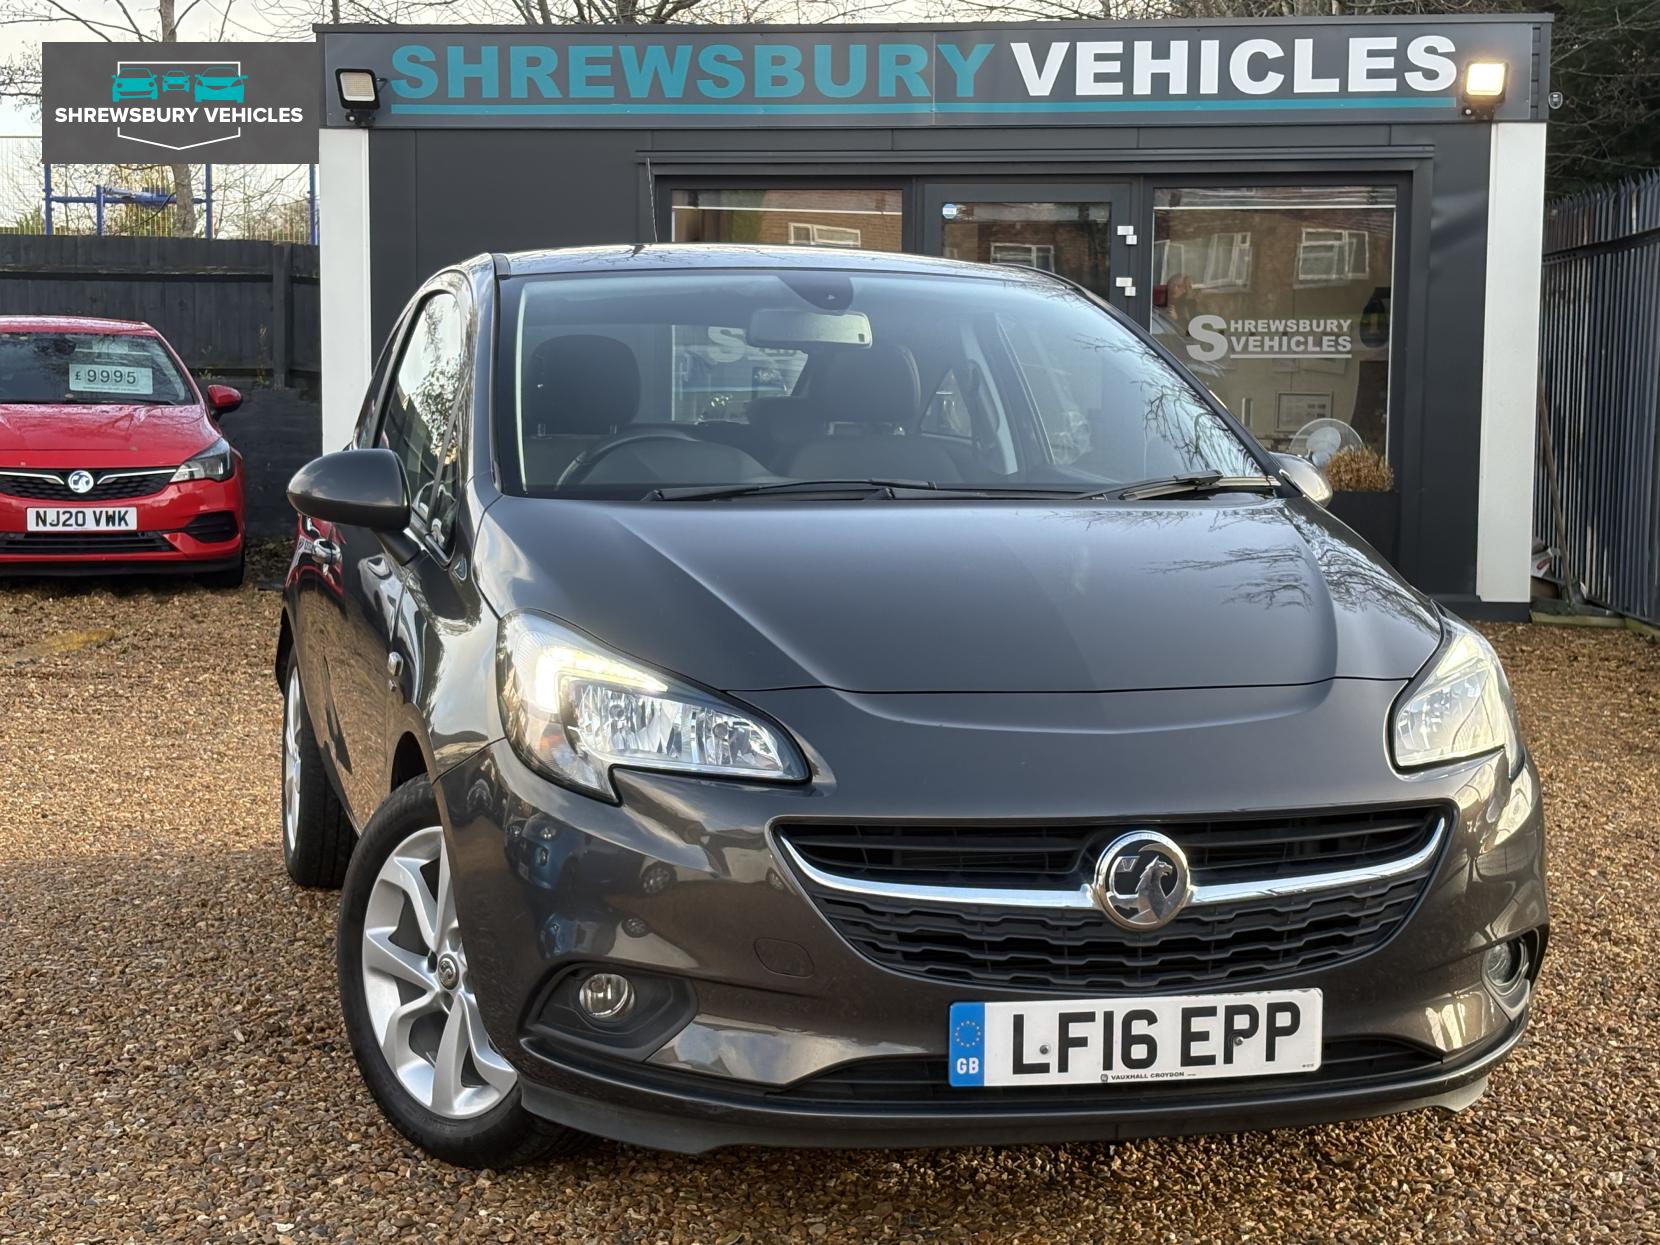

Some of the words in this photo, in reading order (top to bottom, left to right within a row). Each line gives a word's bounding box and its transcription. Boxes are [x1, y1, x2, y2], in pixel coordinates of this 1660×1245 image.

[390, 44, 995, 98] SHREWSBURY
[1010, 34, 1458, 97] VEHICLES
[1186, 314, 1352, 361] SHREWSBURY
[1230, 335, 1352, 352] VEHICLES
[35, 511, 86, 527] NJ20
[93, 510, 129, 527] VWK
[1012, 1008, 1158, 1075] LF16
[1180, 1001, 1301, 1068] EPP
[955, 1057, 980, 1076] GB
